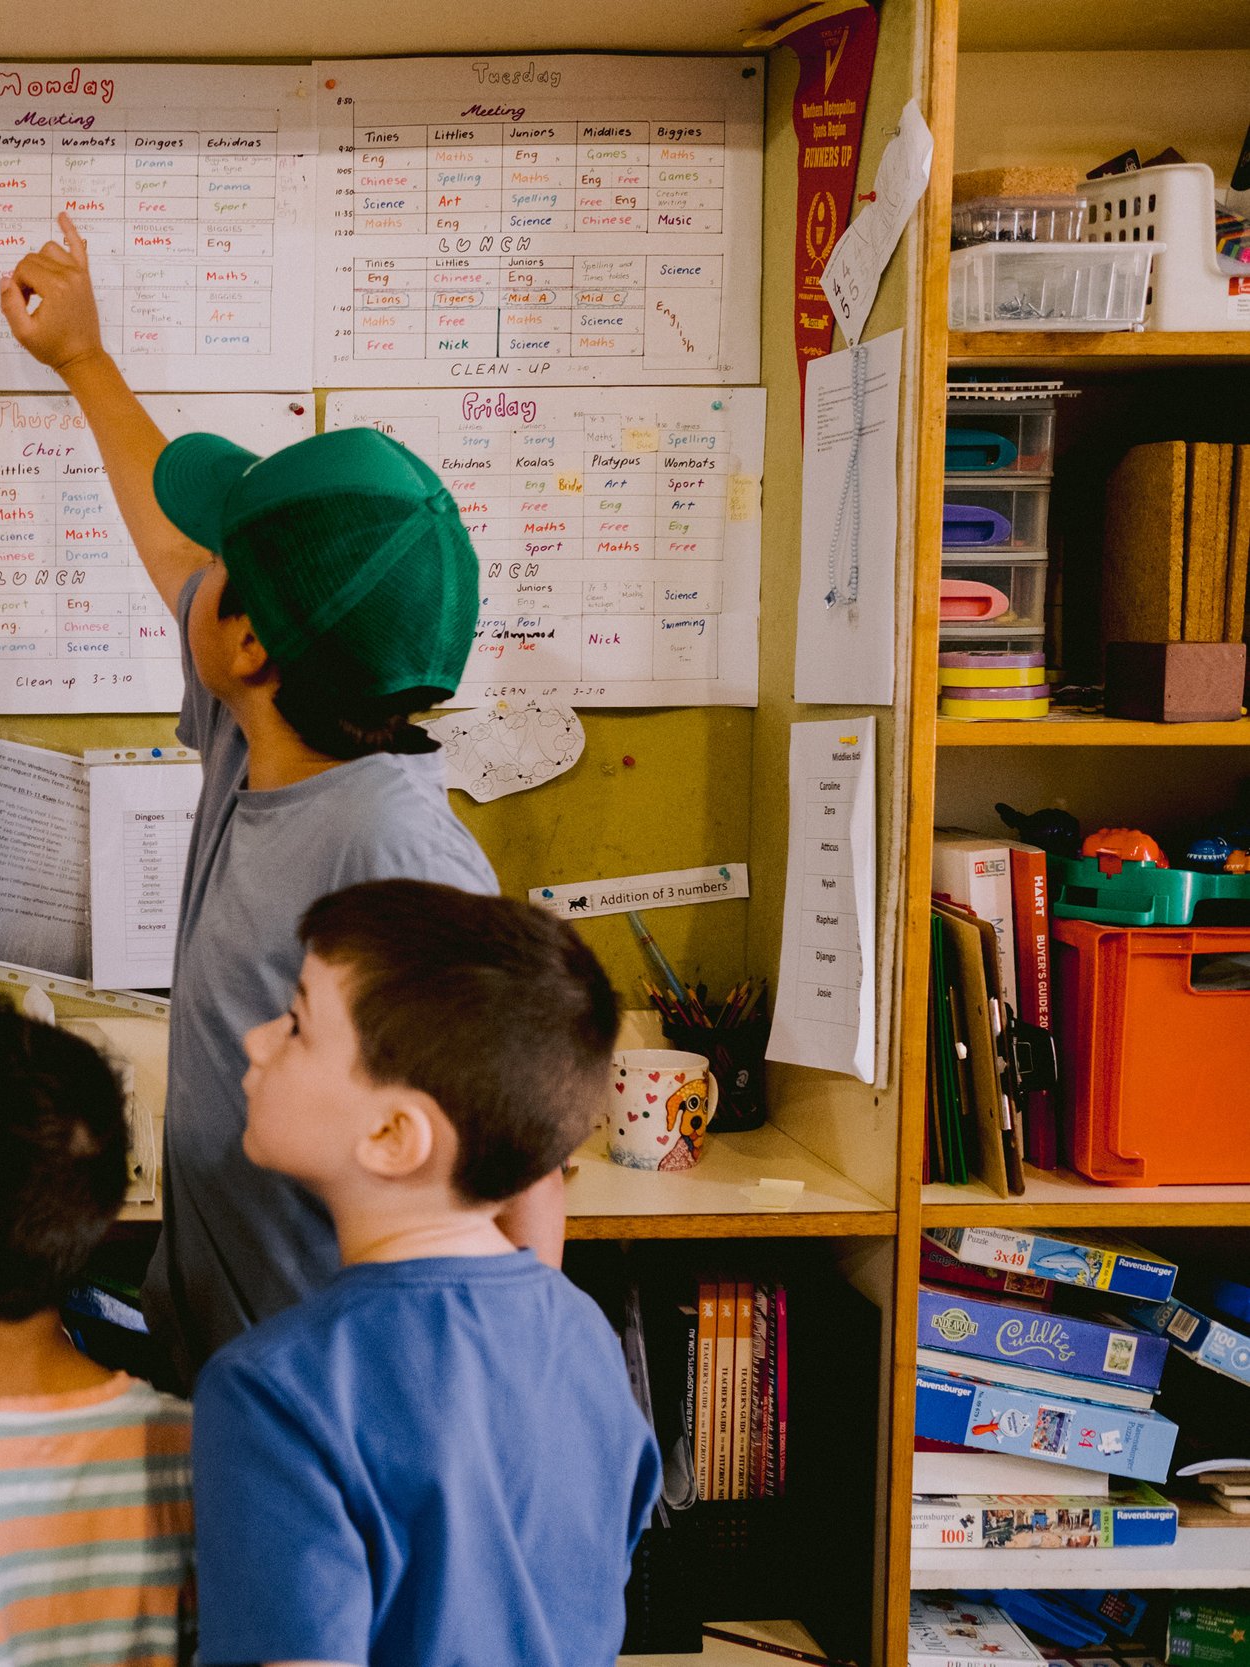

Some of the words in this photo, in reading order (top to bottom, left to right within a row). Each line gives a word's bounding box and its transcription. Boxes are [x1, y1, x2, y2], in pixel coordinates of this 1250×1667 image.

[472, 62, 561, 87] Tuesday
[461, 104, 525, 121] Meeting
[435, 131, 474, 140] Littlies
[510, 128, 554, 138] Juniors
[584, 128, 632, 137] Middlies
[658, 127, 702, 140] Biggies
[828, 121, 847, 140] Region
[62, 137, 116, 147] Wombats
[365, 132, 399, 142] Tinies
[135, 138, 184, 150] Dingoes
[207, 138, 262, 148] Echidnas
[516, 150, 538, 163] Eng
[587, 149, 627, 159] Games
[804, 146, 840, 168] RUNNERS
[842, 146, 852, 167] UP
[363, 154, 385, 168] Eng
[361, 177, 408, 186] Chinese
[438, 173, 481, 186] Spelling
[659, 172, 699, 182] Games
[66, 201, 105, 211] Maths
[364, 198, 405, 209] Science
[439, 196, 461, 207] Art
[512, 194, 557, 207] Spelling
[615, 195, 637, 207] Eng
[139, 203, 167, 212] Free
[215, 202, 248, 214] Sport
[438, 219, 459, 231] Eng
[583, 216, 632, 225] Chinese
[658, 215, 692, 226] Music
[135, 238, 172, 246] Maths
[439, 236, 531, 252] LUNCH
[366, 260, 395, 268] Tinies
[508, 258, 544, 267] Juniors
[661, 265, 701, 276] Science
[207, 272, 247, 281] Maths
[367, 295, 401, 304] Lions
[438, 294, 475, 304] Tigers
[509, 294, 530, 302] Mid
[538, 294, 547, 302] A
[581, 294, 603, 302] Mid
[614, 294, 621, 302] C
[210, 310, 235, 322] Art
[439, 316, 465, 326] Free
[581, 316, 623, 325] Science
[205, 335, 249, 344] Drama
[439, 340, 469, 349] Nick
[367, 341, 394, 350] Free
[451, 363, 509, 376] CLEAN
[529, 363, 550, 373] UP
[462, 392, 536, 423] Friday
[462, 437, 490, 448] Story
[524, 437, 555, 448] Story
[668, 433, 716, 449] Spelling
[23, 443, 75, 457] Choir
[442, 459, 491, 469] Echidnas
[516, 457, 554, 468] Koalas
[592, 455, 641, 469] Platypus
[665, 458, 715, 469] Wombats
[63, 465, 107, 475] Juniors
[605, 480, 627, 488] Art
[668, 479, 705, 494] Sport
[62, 492, 99, 501] Passion
[672, 501, 695, 510] Art
[64, 505, 102, 518] Project
[66, 528, 108, 540] Maths
[598, 543, 639, 552] Maths
[517, 584, 552, 593] Juniors
[518, 618, 541, 628] Pool
[662, 619, 705, 635] Swimming
[140, 627, 167, 638] Nick
[589, 634, 620, 645] Nick
[478, 644, 504, 659] Craig
[518, 642, 536, 651] Sue
[16, 676, 53, 687] Clean
[62, 678, 76, 689] up
[485, 688, 526, 697] CLEAN
[543, 688, 557, 696] UP
[820, 782, 841, 791] Caroline
[824, 806, 836, 815] Zera
[135, 814, 165, 822] Dingoes
[821, 843, 839, 852] Atticus
[822, 879, 836, 889] Nyah
[600, 890, 649, 907] Addition
[652, 888, 664, 900] of
[668, 887, 675, 898] 3
[678, 881, 728, 897] numbers
[1034, 876, 1045, 917] HART
[816, 915, 839, 926] Raphael
[816, 952, 836, 963] Django
[1036, 935, 1047, 980] BUYER'S
[817, 988, 832, 998] Josie
[1038, 982, 1048, 1017] GUIDE
[967, 1234, 989, 1246] Puzzle
[994, 1249, 1025, 1266] 3x49
[1118, 1258, 1173, 1277] Ravensburger
[931, 1315, 978, 1336] ENDEAVOUR
[996, 1319, 1076, 1362] Cuddlies
[1213, 1331, 1237, 1348] 100
[720, 1368, 728, 1410] TEACHER'S
[916, 1379, 972, 1397] Ravensburger
[1078, 1428, 1096, 1448] 84
[1117, 1510, 1174, 1521] Ravensburger
[942, 1530, 965, 1543] 100
